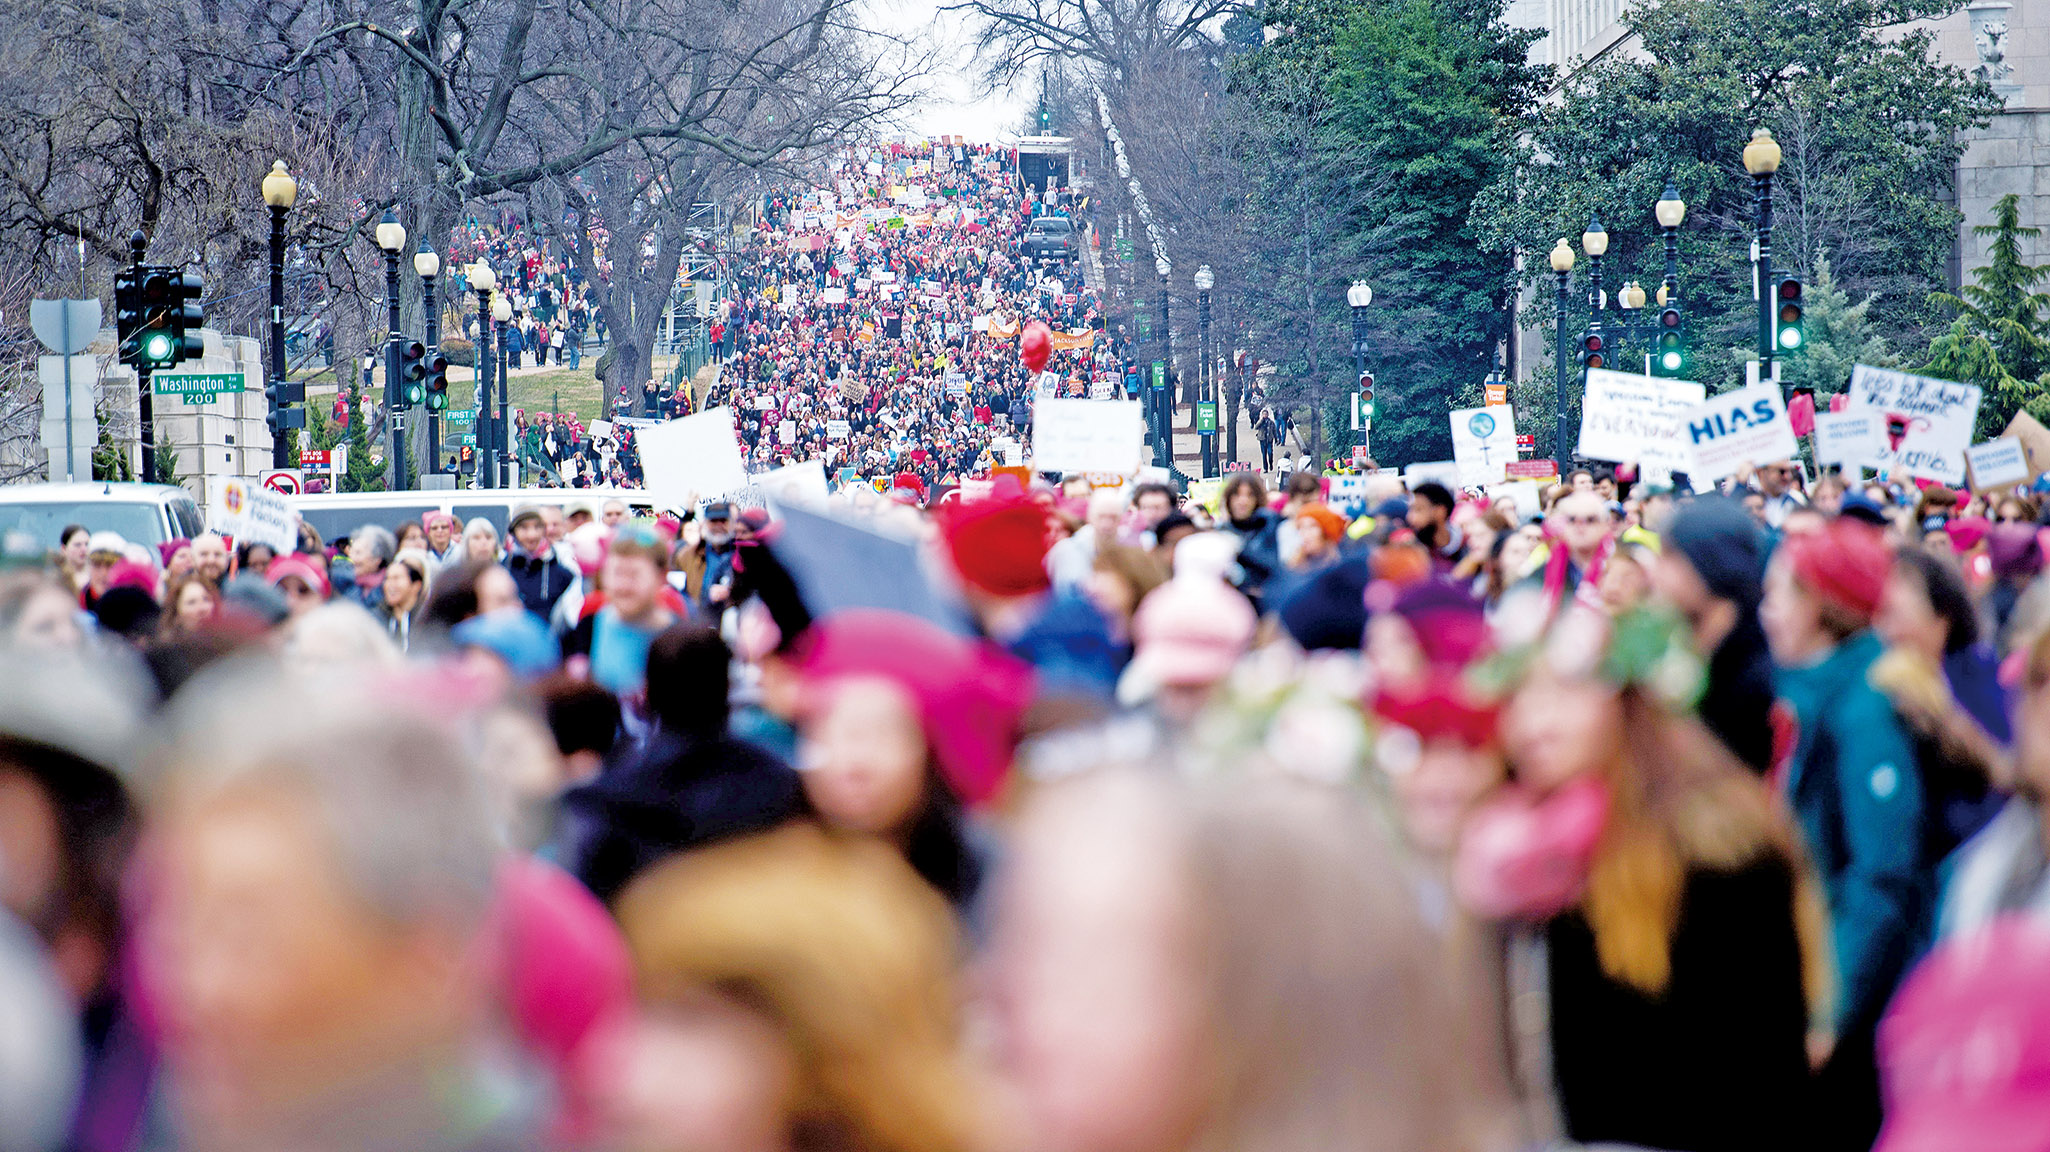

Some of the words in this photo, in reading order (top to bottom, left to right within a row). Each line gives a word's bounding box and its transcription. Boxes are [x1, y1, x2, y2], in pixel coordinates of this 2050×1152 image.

[159, 376, 224, 394] Washington
[186, 393, 213, 404] 200
[447, 411, 469, 419] FIRST
[1689, 398, 1776, 445] HIAS
[1223, 461, 1250, 473] LOVE
